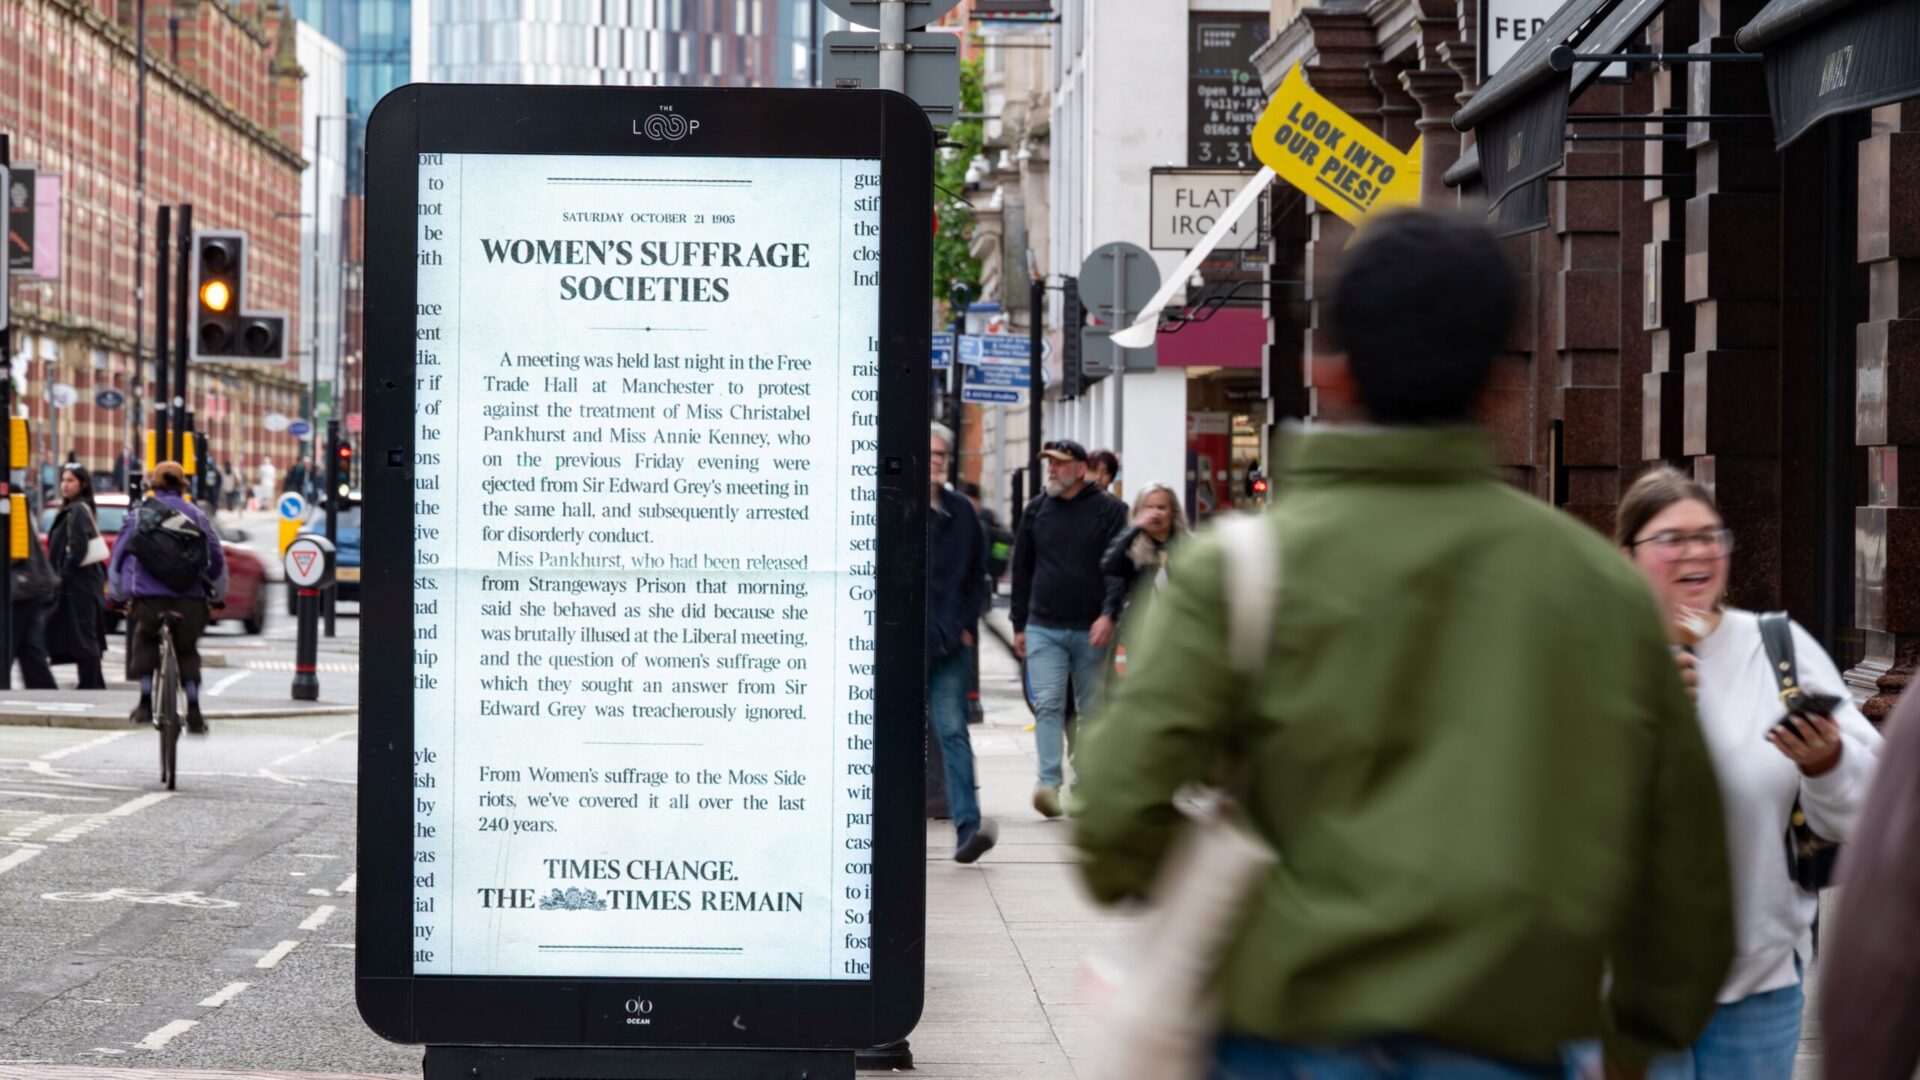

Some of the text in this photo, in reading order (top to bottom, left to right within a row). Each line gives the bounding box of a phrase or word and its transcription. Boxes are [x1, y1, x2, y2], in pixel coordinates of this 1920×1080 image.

[1287, 101, 1396, 185] LOOK INTO
[1274, 124, 1382, 206] OUR PIES!
[428, 177, 444, 191] to
[1176, 188, 1236, 208] FLAT
[563, 212, 735, 225] SATURDAY OCTOBER 21 1905
[424, 225, 443, 240] be
[480, 238, 809, 269] WOMEN'S SUFFRAGE
[560, 275, 729, 303] SOCIETIES
[500, 351, 811, 374] A meeting was held last night in the Free
[429, 375, 442, 390] if
[484, 376, 810, 400] Trade Hall at Manchester to protest
[425, 400, 442, 415] of
[483, 401, 810, 421] against the treatment of Miss Christabel
[422, 425, 441, 440] he
[484, 426, 810, 448] Pankhurst and Miss Annie Kenney, who
[483, 451, 810, 473] on the previous Friday evening were
[482, 476, 808, 499] ejected from Sir Edward Grey's meeting in
[482, 501, 808, 523] the same hall, and subsequently arrested
[482, 525, 653, 546] for disorderly conduct.
[498, 551, 807, 572] Miss Pankhurst, who had been released
[481, 574, 808, 599] from Strangeways Prison that morning,
[481, 600, 808, 621] said she behaved as she did because she
[481, 625, 807, 649] was brutally illused at the Liberal meeting,
[480, 650, 807, 673] and the question of women's suffrage on
[480, 675, 807, 696] which they sought an answer from Sir
[481, 700, 806, 724] Edward Grey was treacherously ignored.
[480, 766, 806, 788] From Women's suffrage to the Moss Side
[417, 798, 436, 816] by
[479, 790, 805, 811] riots, we've covered it all over the last
[479, 816, 557, 835] 240 years.
[543, 858, 738, 882] TIMES CHANGE.
[477, 887, 803, 913] THE TIMES REMAIN
[845, 886, 861, 899] to
[844, 909, 864, 924] So
